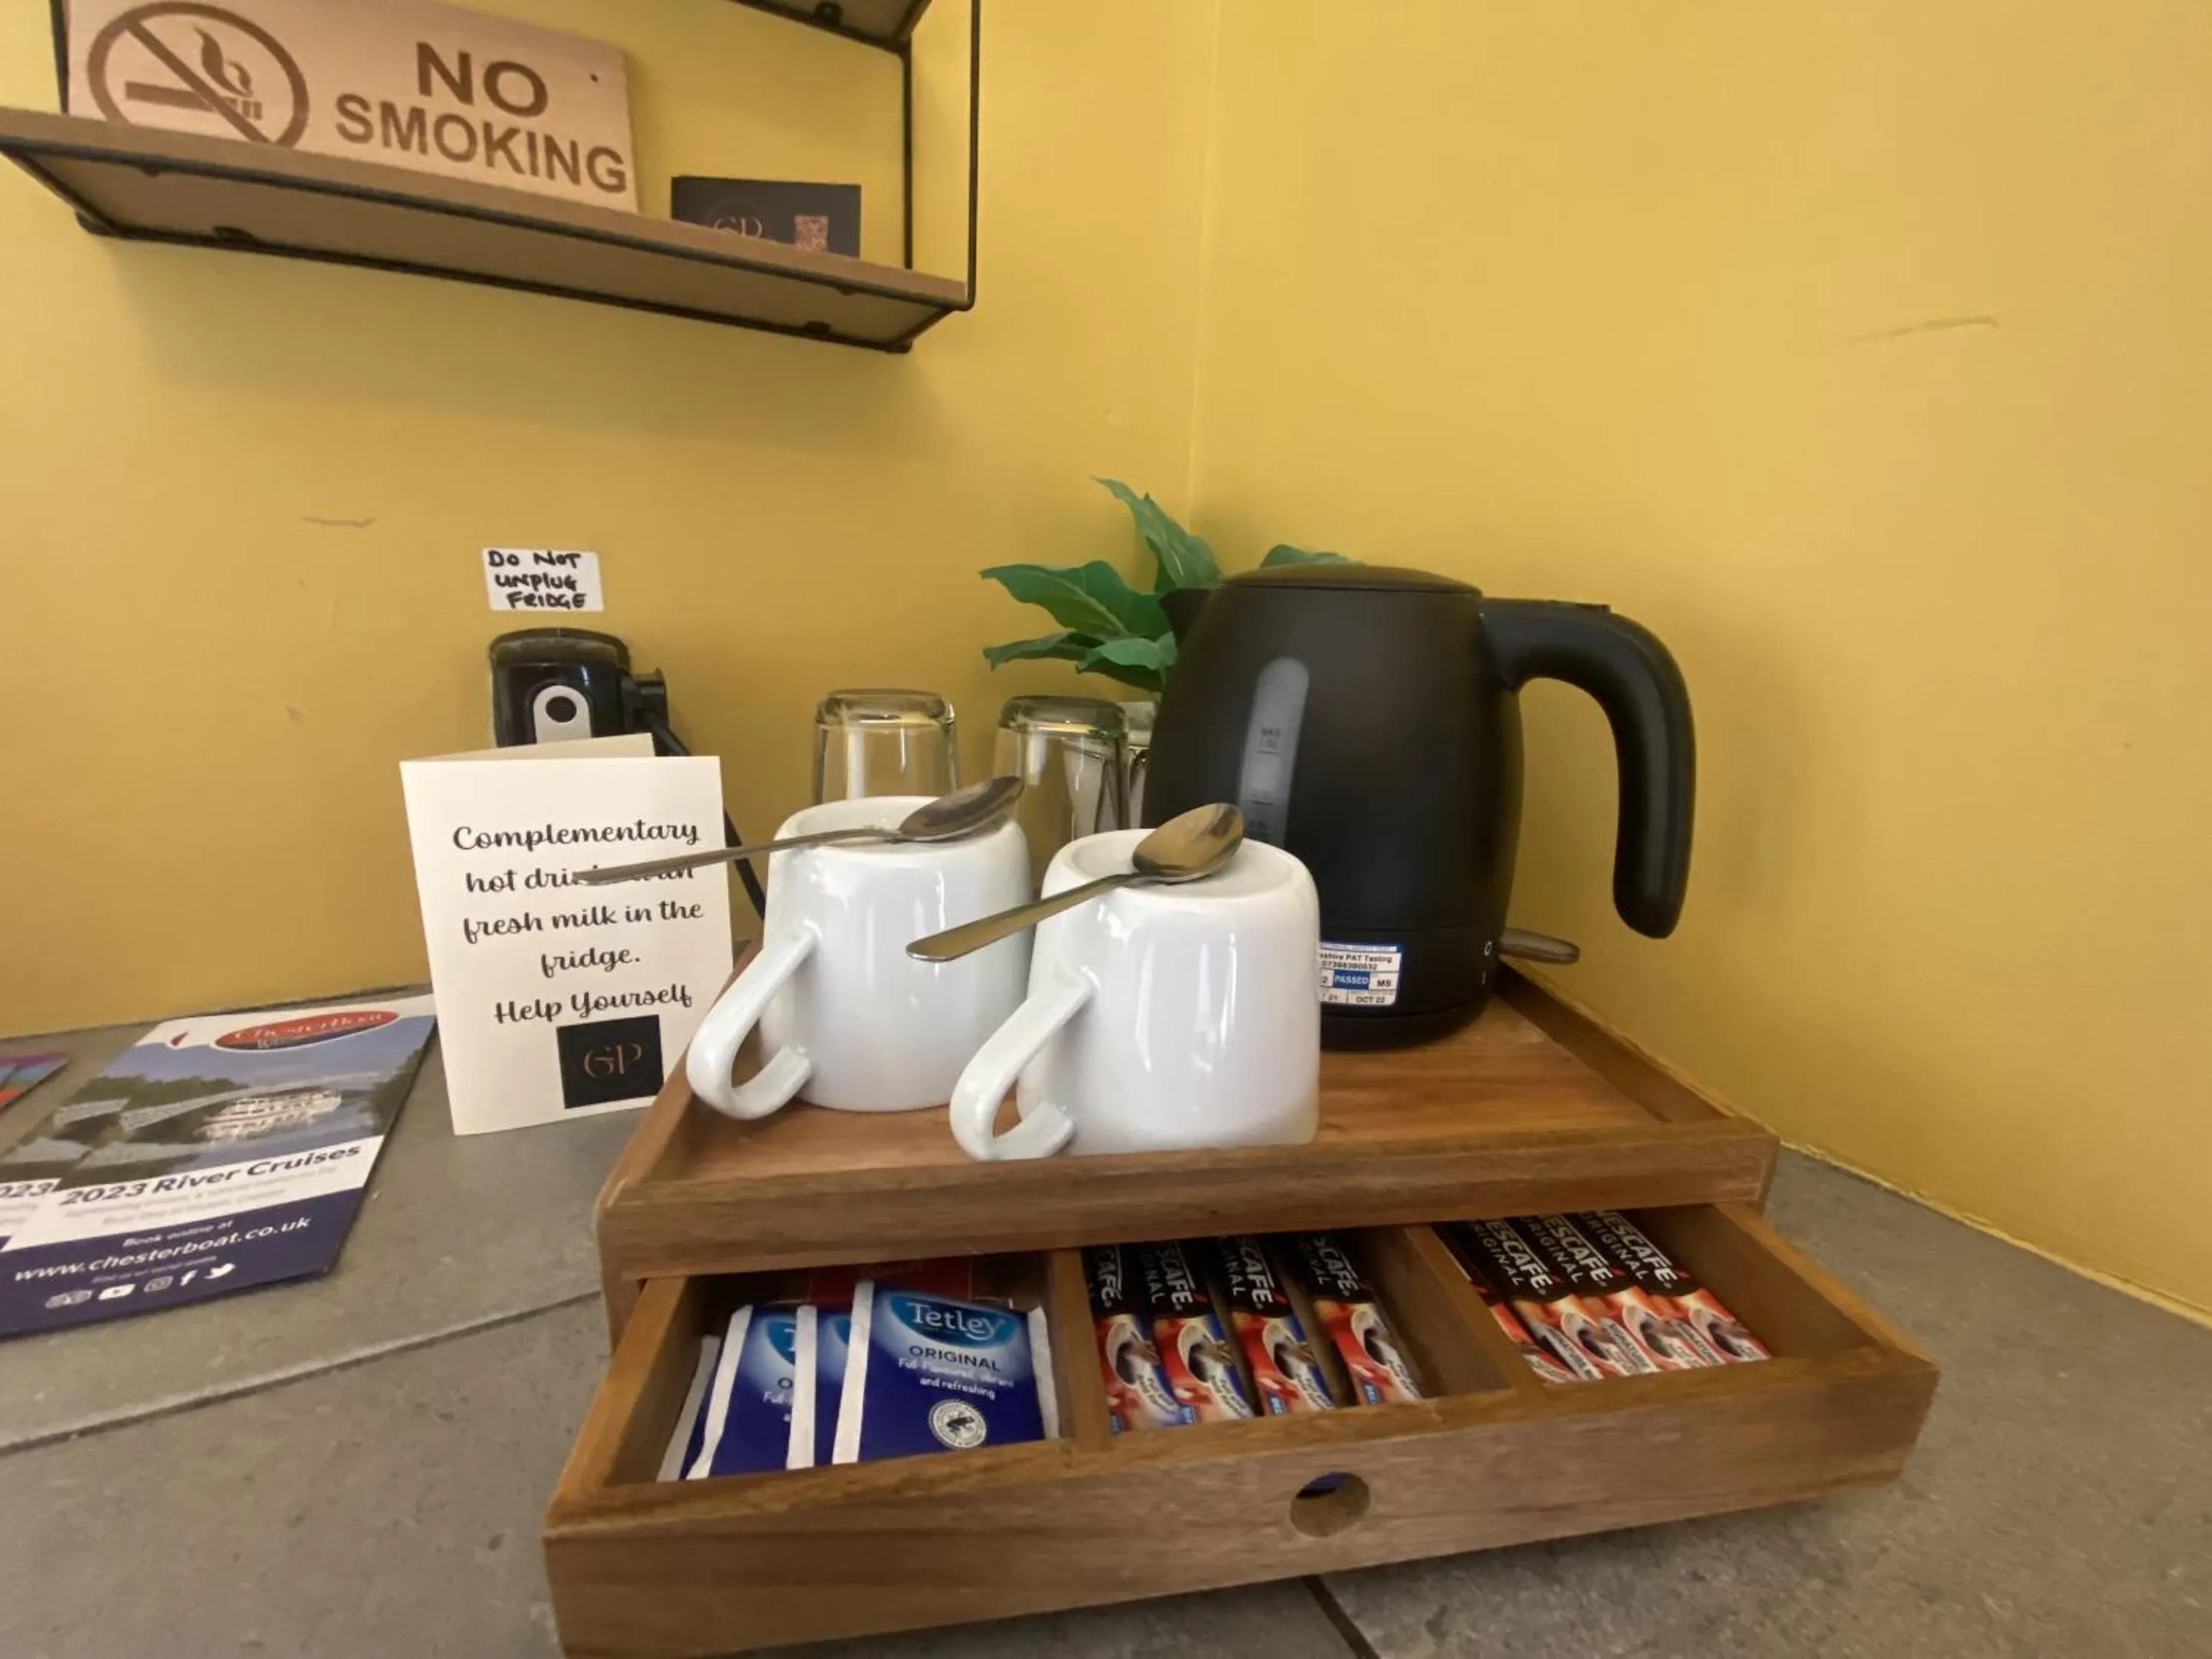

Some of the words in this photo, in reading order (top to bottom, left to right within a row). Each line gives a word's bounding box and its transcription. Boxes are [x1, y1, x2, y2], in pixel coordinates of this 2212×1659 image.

[415, 41, 548, 117] NO
[336, 94, 627, 193] SMOKING
[507, 591, 587, 610] FRIDGE
[453, 819, 702, 851] Complementary
[465, 869, 517, 893] hot
[464, 911, 543, 945] fresh
[551, 905, 618, 930] milk
[624, 904, 652, 924] in
[659, 899, 704, 920] the
[541, 947, 641, 979] fridge.
[1364, 955, 1393, 964] Testing
[1334, 974, 1370, 985] PASSED
[494, 998, 562, 1025] Help
[571, 983, 693, 1018] Yourself
[59, 1182, 148, 1205] 2023
[152, 1168, 242, 1195] River
[247, 1144, 362, 1178] Cruises
[14, 1216, 312, 1282] www.chesterboat.co.uk
[907, 1301, 1005, 1341] Tetley
[908, 1345, 1001, 1373] ORIGINAL
[920, 1376, 941, 1387] and
[941, 1380, 996, 1401] refreshing
